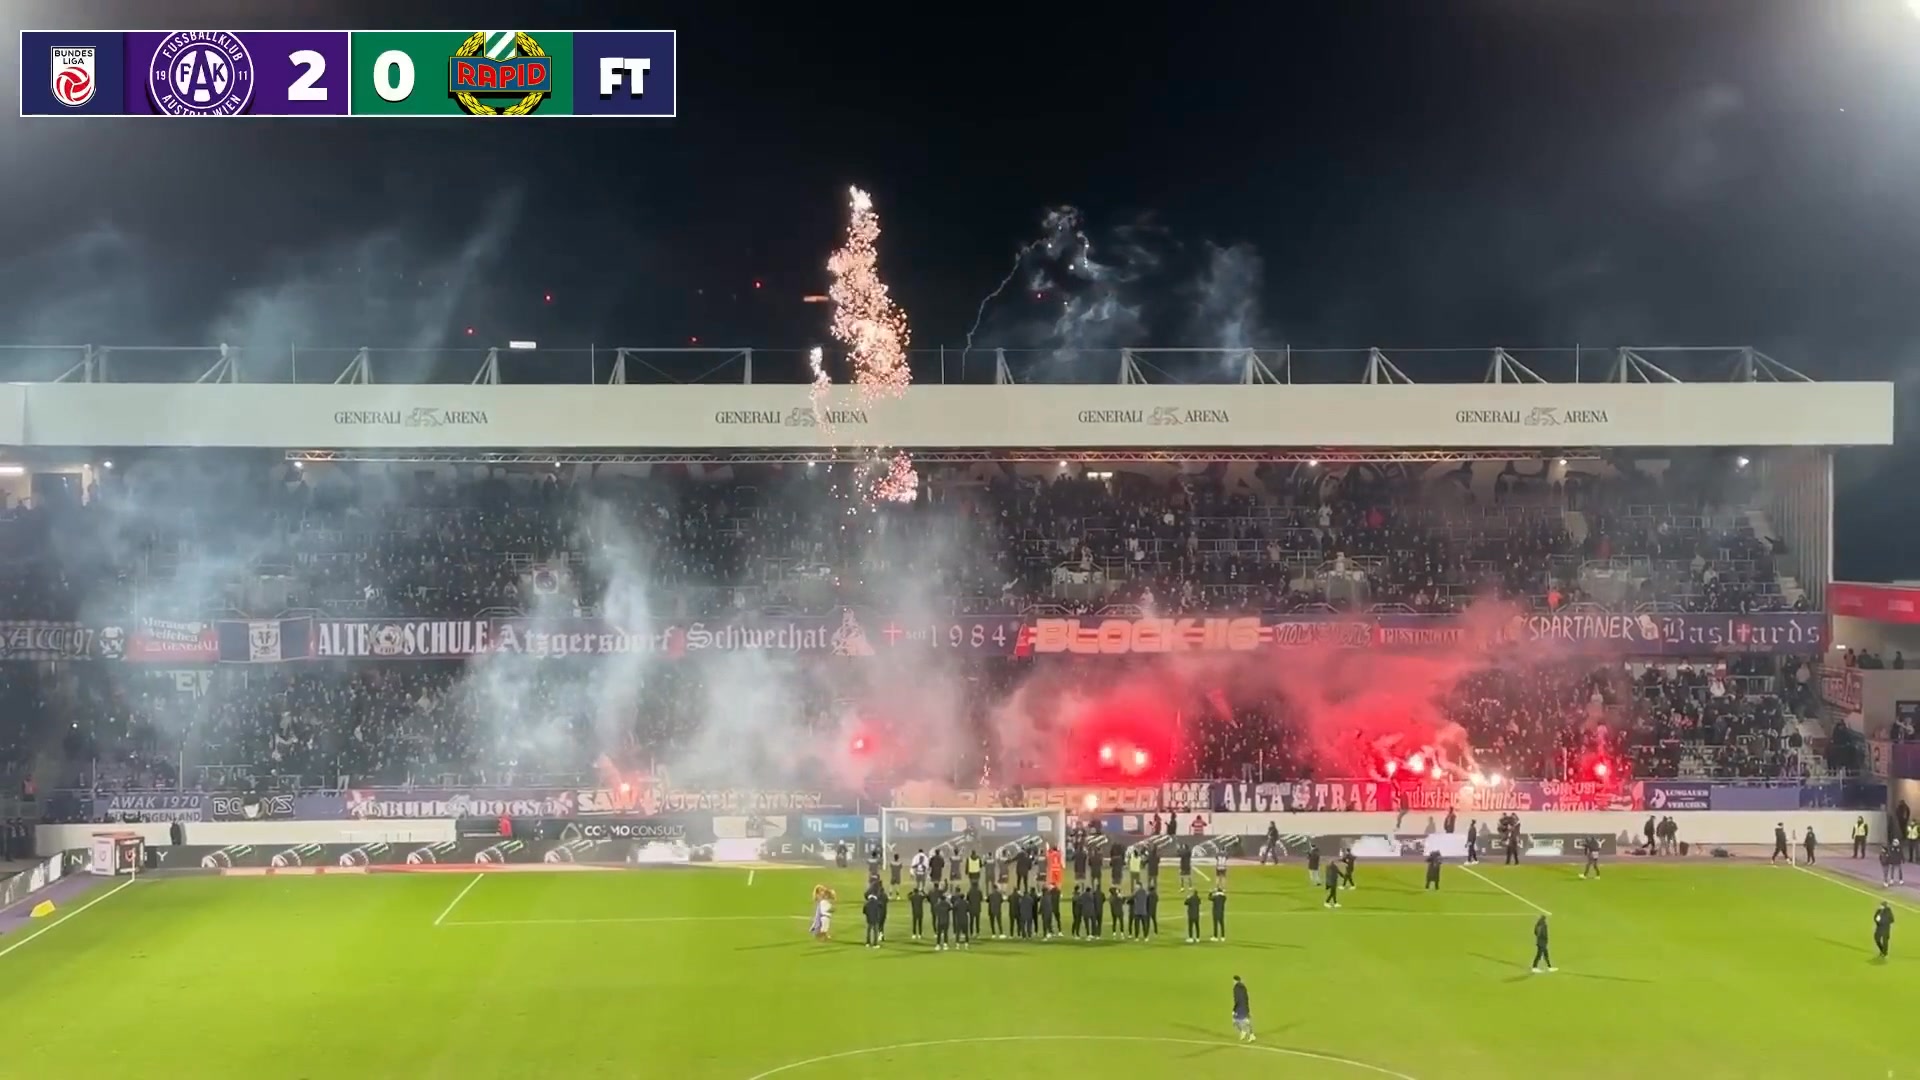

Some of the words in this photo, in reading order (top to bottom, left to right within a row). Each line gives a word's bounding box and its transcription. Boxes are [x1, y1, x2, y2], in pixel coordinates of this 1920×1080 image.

[334, 410, 400, 424] GENERALI
[443, 410, 488, 424] ARENA
[715, 410, 781, 424] GENERALI
[823, 410, 868, 424] ARENA
[1078, 409, 1143, 423] GENERALI
[1184, 409, 1229, 423] ARENA
[1456, 409, 1520, 423] GENERALI
[1564, 409, 1608, 423] ARENA
[318, 622, 369, 656] ALTE
[403, 620, 489, 655] SCHULE
[686, 623, 827, 650] Schwechat
[931, 624, 1007, 648] 1984
[1034, 617, 1196, 653] BLOCK
[1529, 615, 1634, 642] SPARTANER
[496, 623, 676, 658] Atzgersdorf
[110, 796, 156, 808] AWAK
[163, 796, 199, 808] 1970
